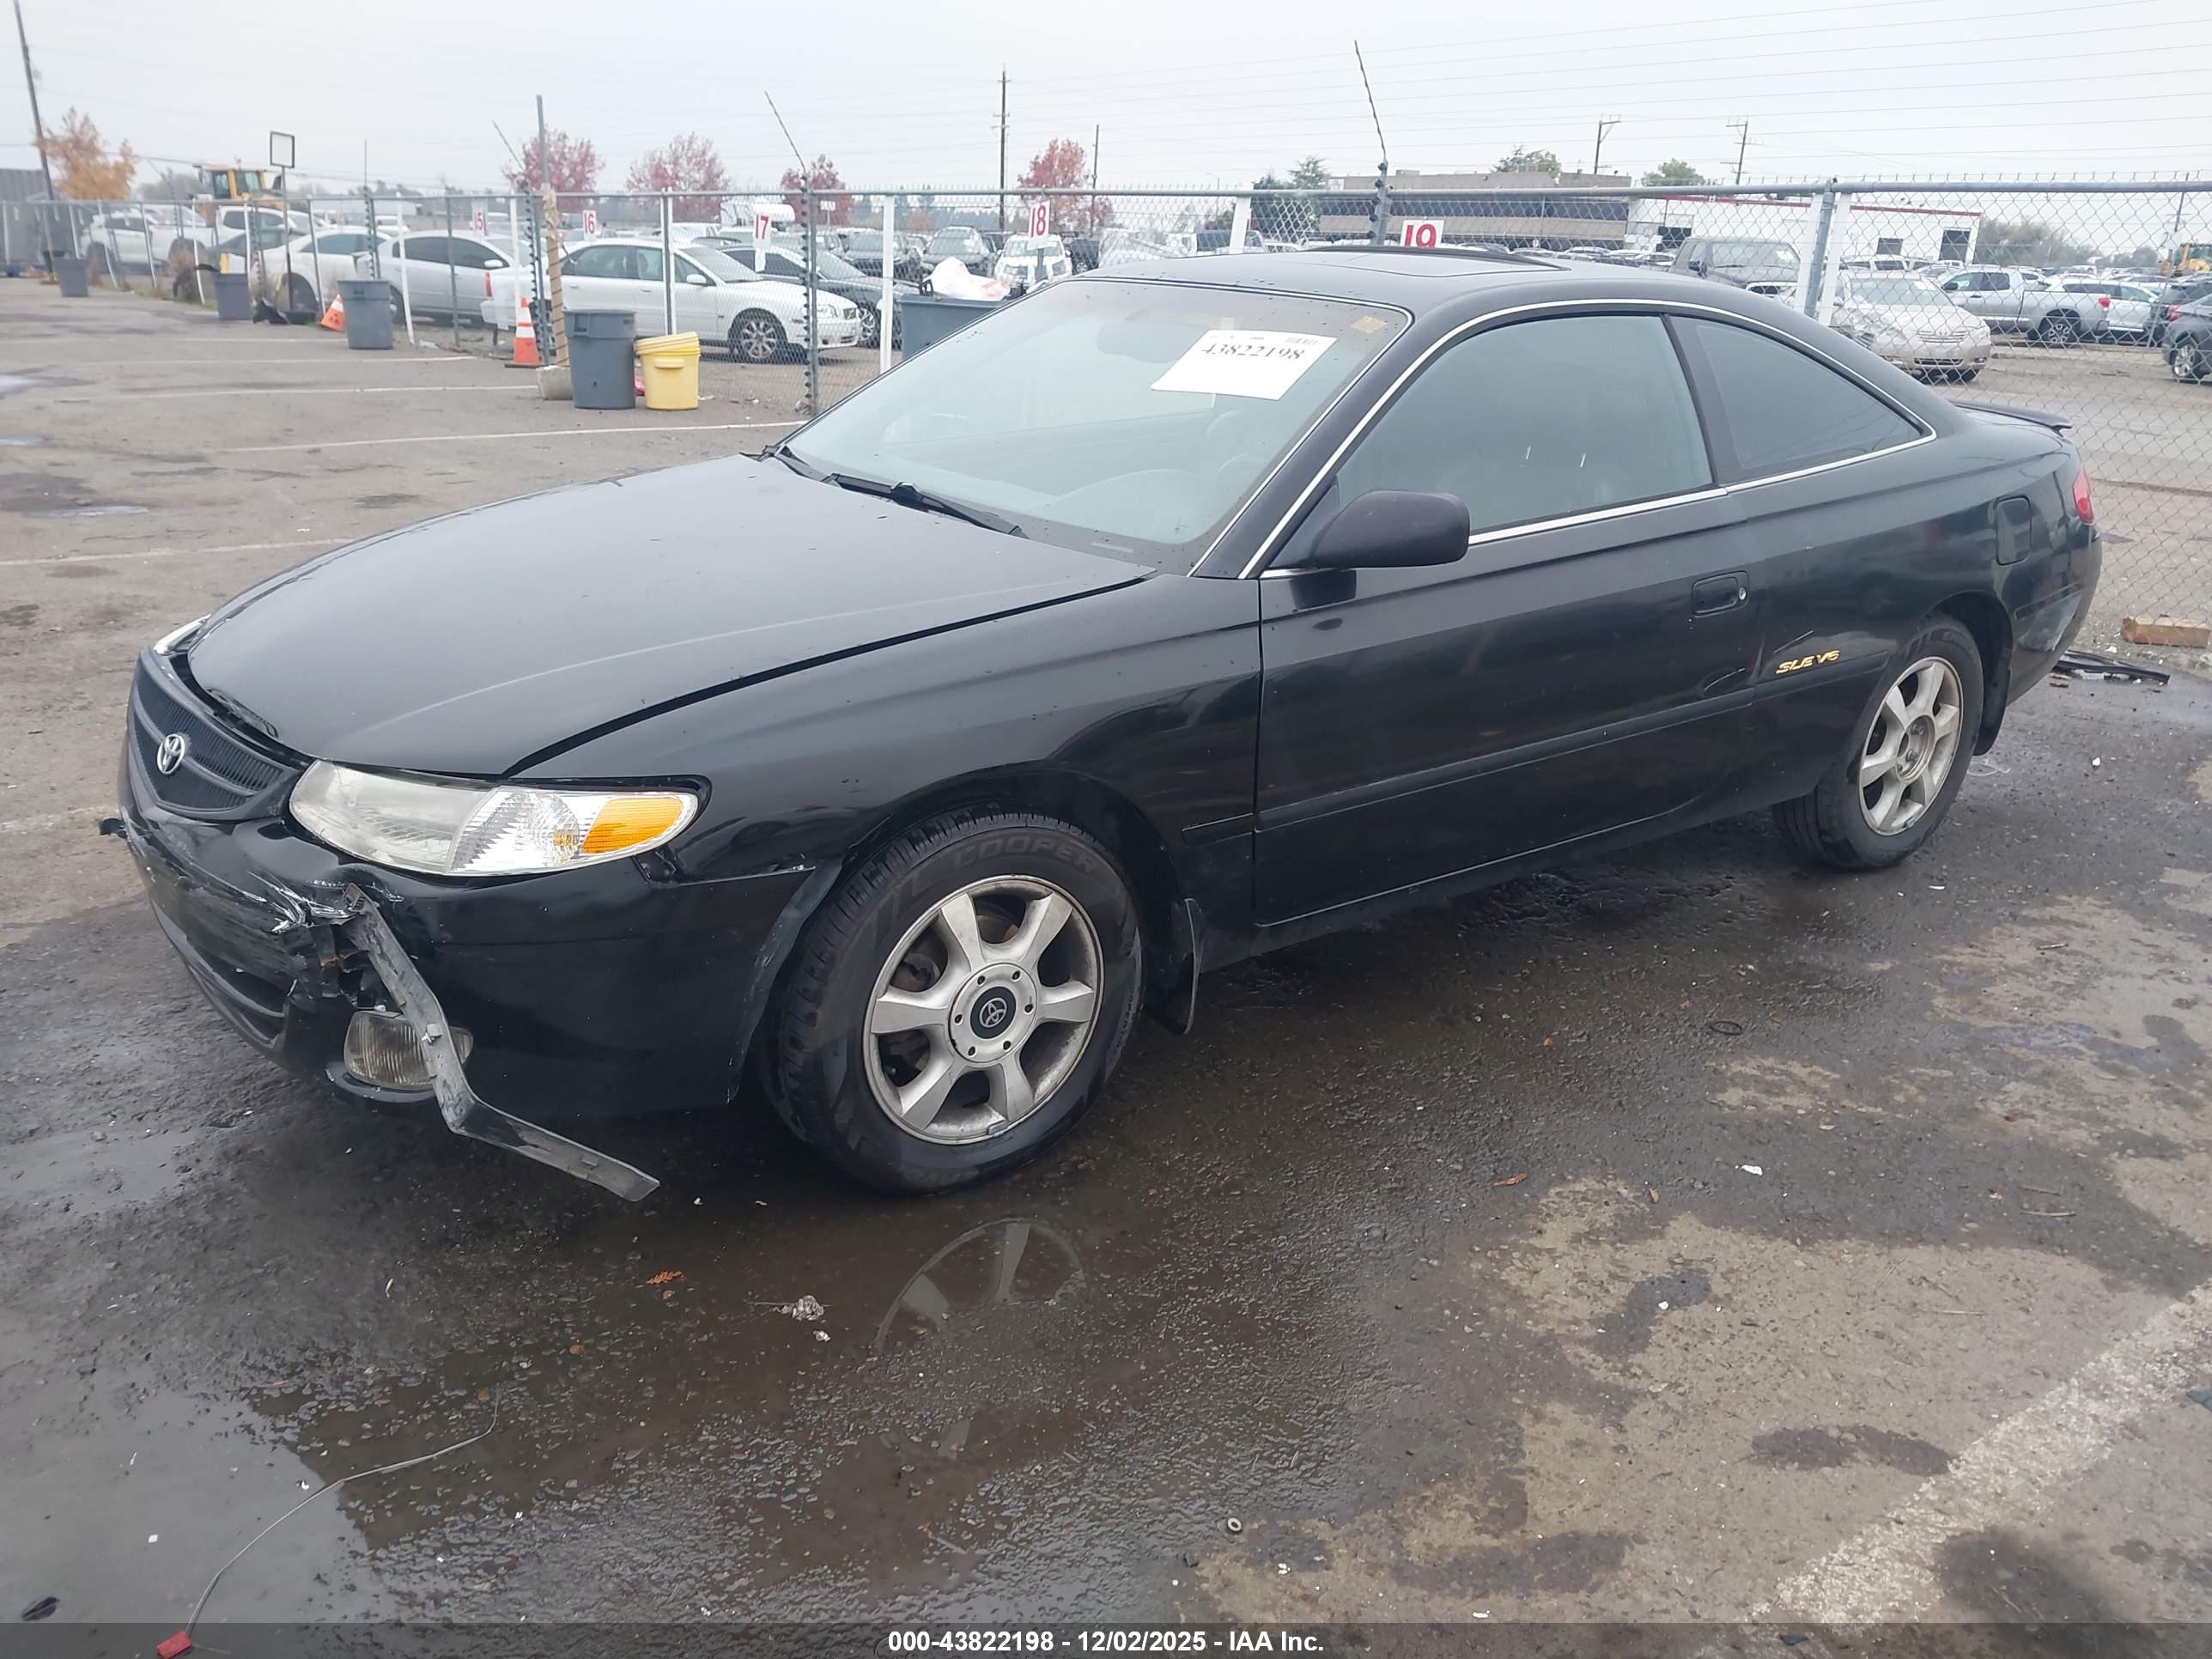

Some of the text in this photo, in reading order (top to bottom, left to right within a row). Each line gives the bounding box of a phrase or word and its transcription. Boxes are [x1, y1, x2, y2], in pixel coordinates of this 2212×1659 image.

[584, 213, 595, 234] 16
[756, 214, 769, 240] 17
[1030, 205, 1047, 238] 18
[1202, 343, 1305, 360] 43822198
[953, 835, 1098, 874] COOPER
